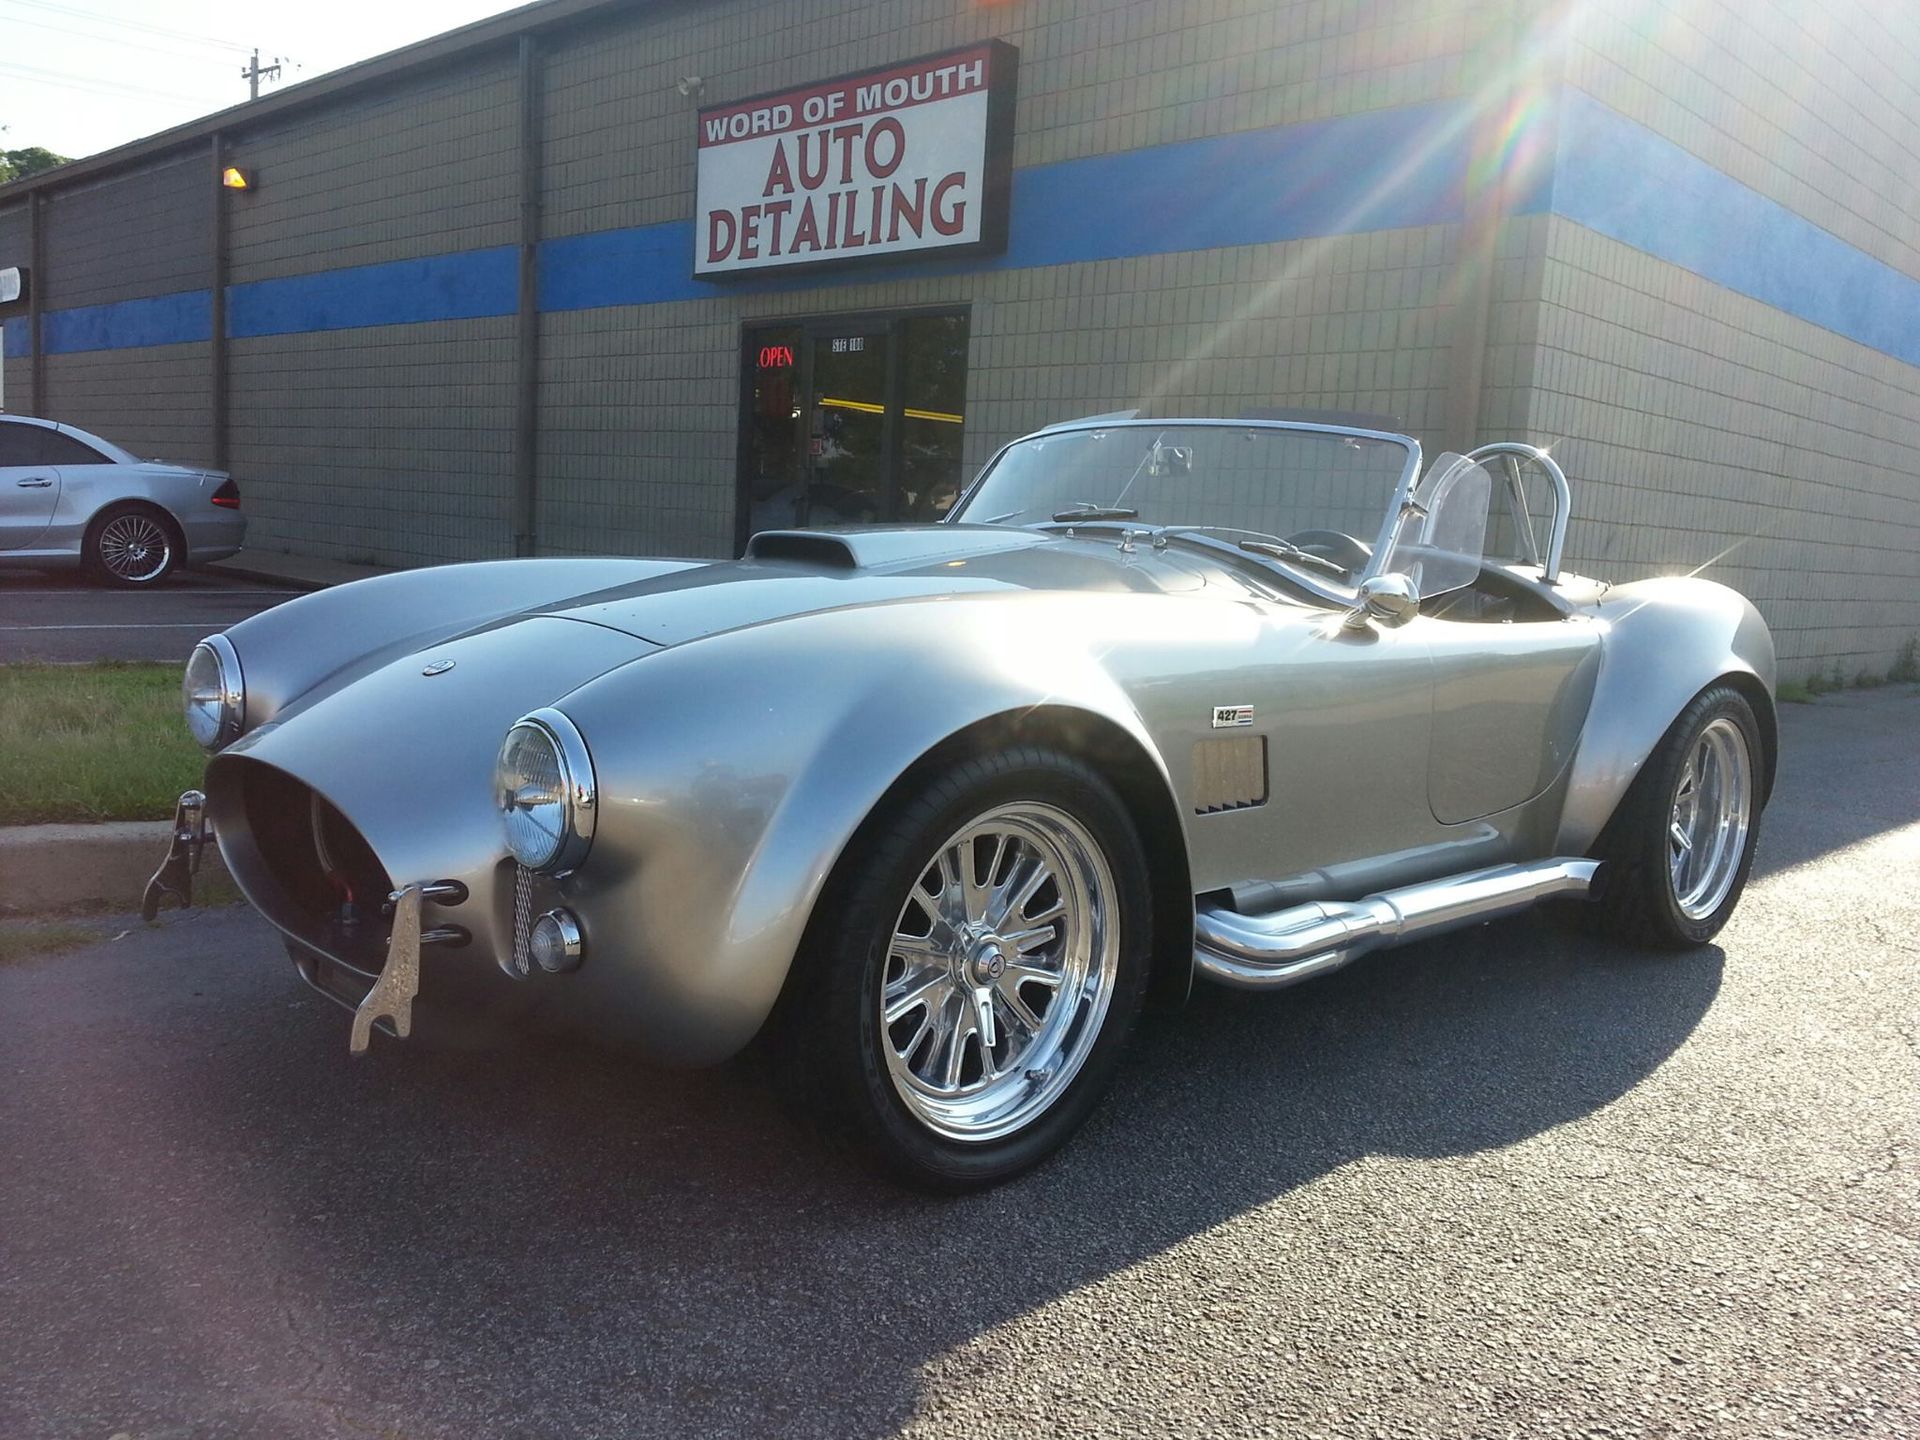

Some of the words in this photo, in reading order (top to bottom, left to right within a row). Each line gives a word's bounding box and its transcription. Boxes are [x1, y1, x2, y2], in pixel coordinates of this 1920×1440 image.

[706, 104, 793, 142] WORD
[803, 92, 845, 123] OF
[856, 60, 983, 113] MOUTH
[762, 117, 906, 198] AUTO
[707, 172, 966, 263] DETAILING
[760, 346, 793, 368] OPEN
[1217, 709, 1238, 721] 427
